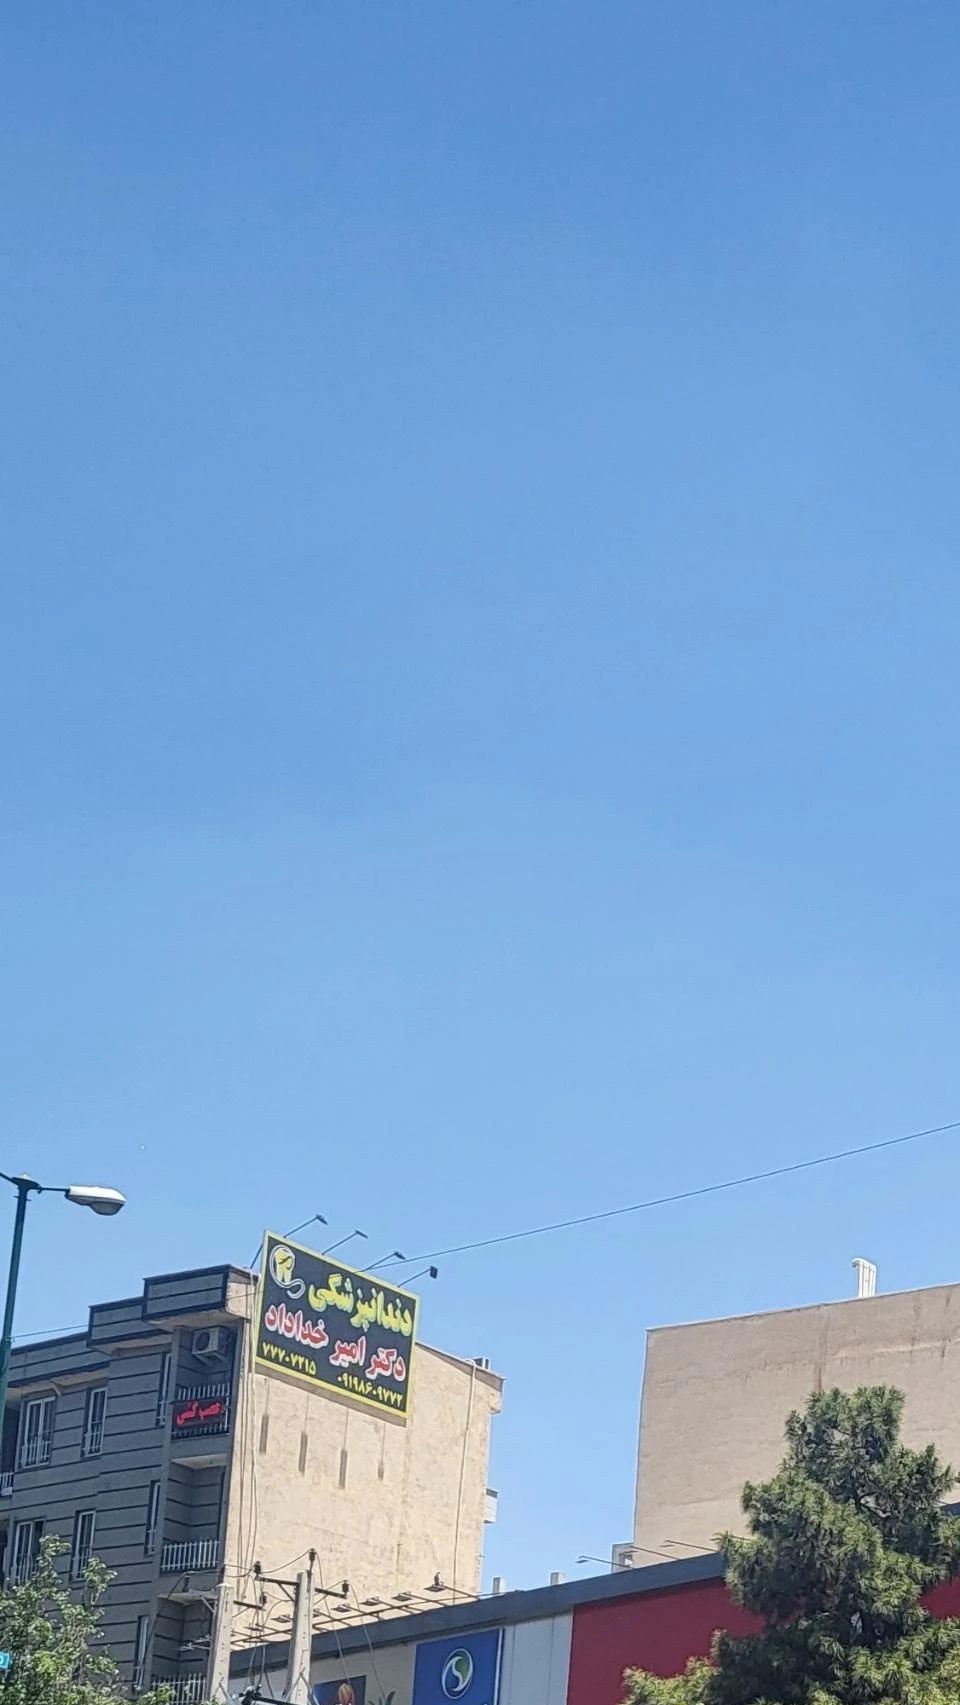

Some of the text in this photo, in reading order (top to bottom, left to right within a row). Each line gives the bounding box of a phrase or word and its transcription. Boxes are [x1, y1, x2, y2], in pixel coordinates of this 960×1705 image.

[308, 1273, 413, 1336] دندانپزشکی
[265, 1303, 406, 1381] دکتر امیر خداداد
